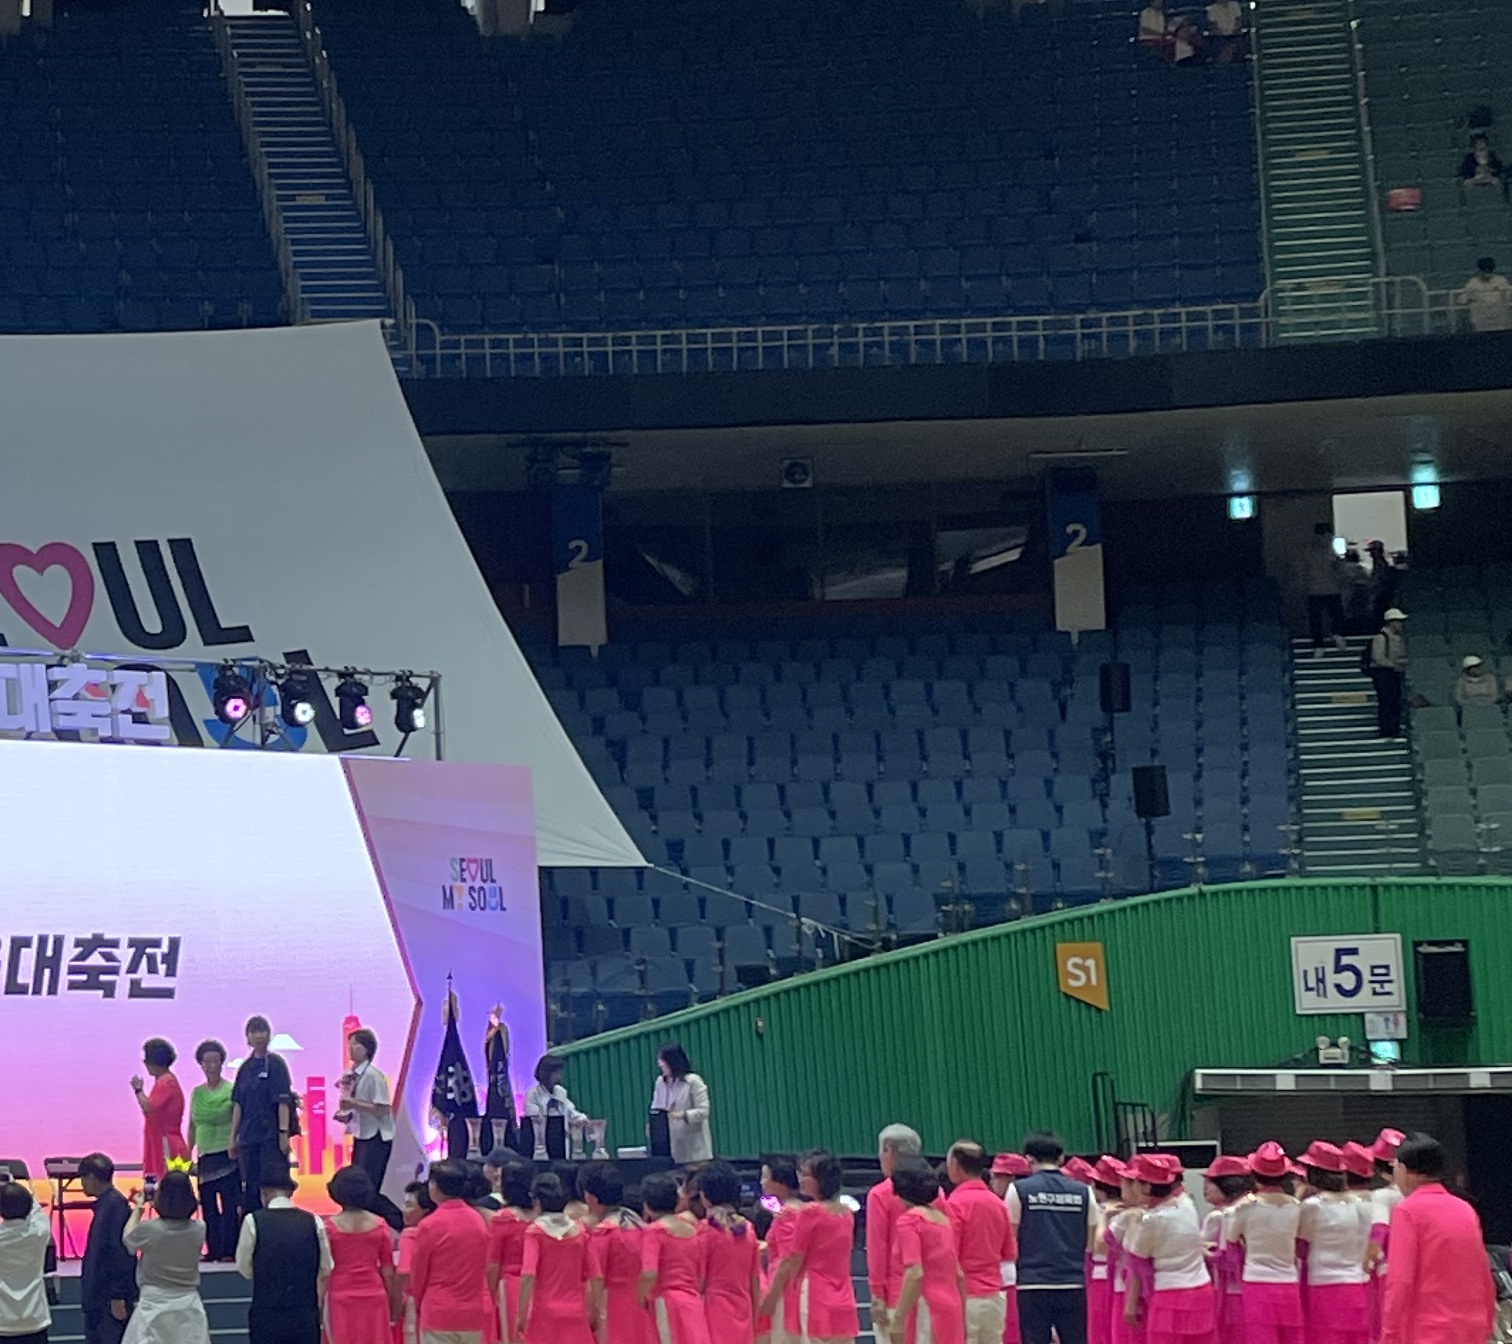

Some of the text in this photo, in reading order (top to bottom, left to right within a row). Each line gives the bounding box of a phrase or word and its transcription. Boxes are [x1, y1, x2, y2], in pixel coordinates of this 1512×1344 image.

[1065, 523, 1087, 553] 2
[568, 539, 589, 569] 2
[468, 885, 507, 912] SOUL
[1067, 957, 1097, 987] S1
